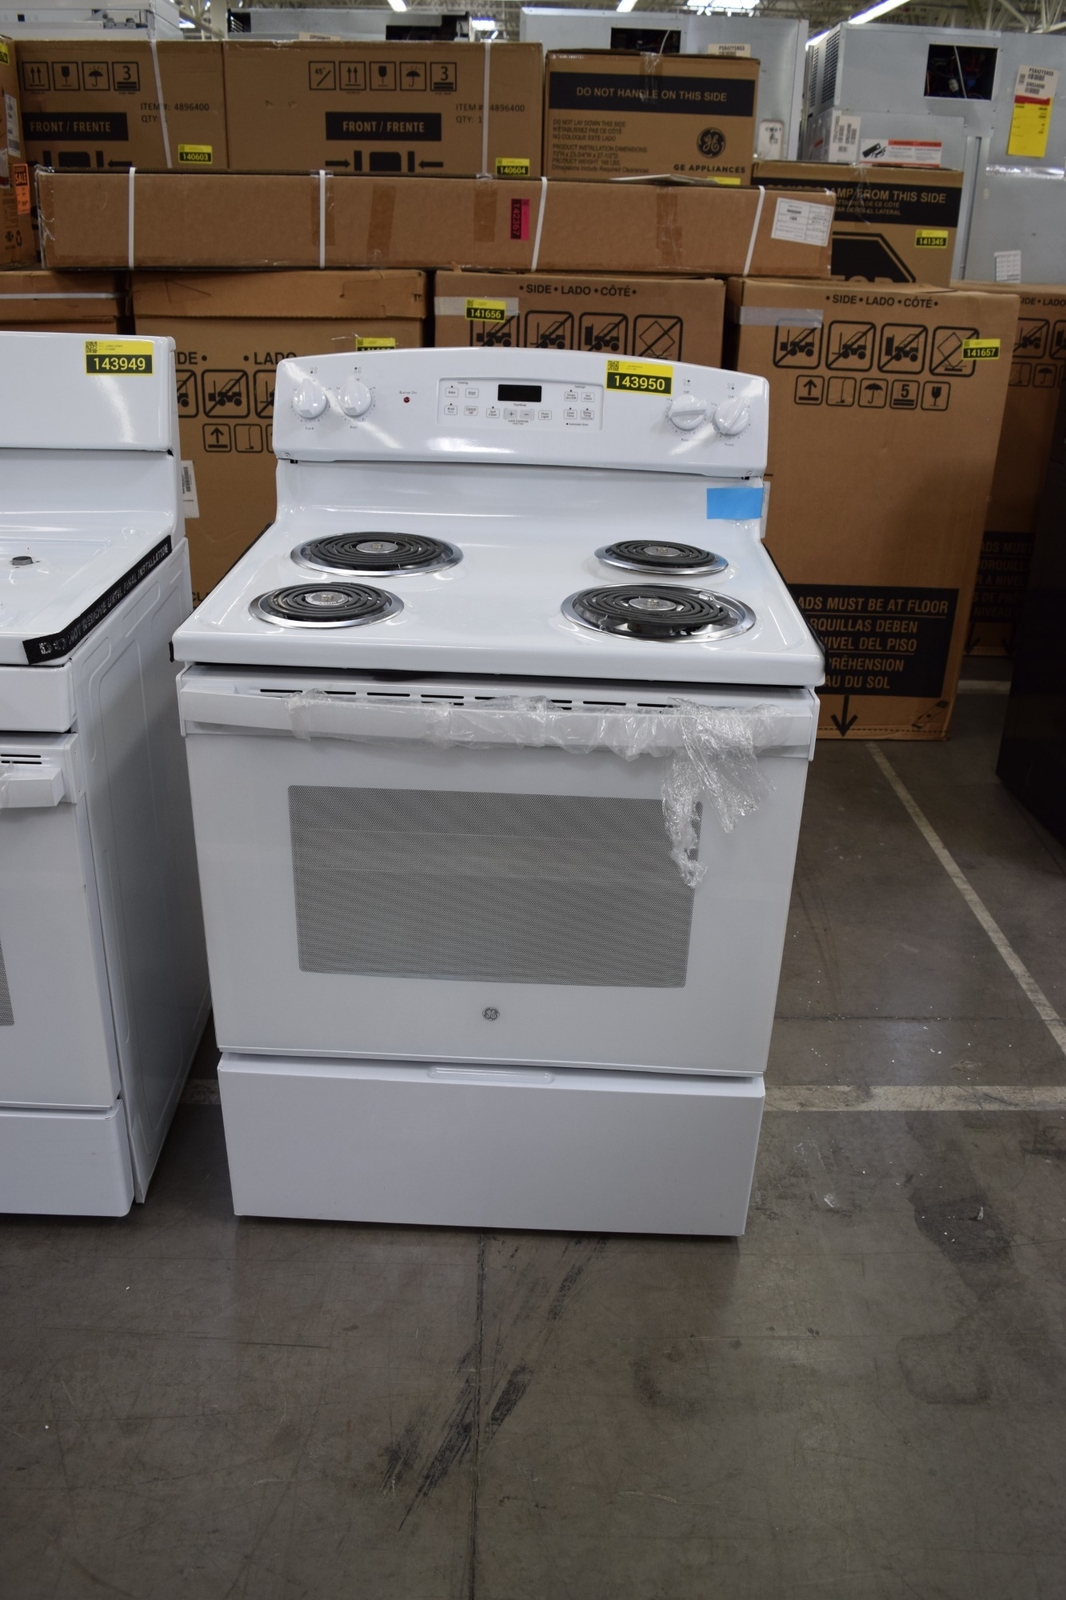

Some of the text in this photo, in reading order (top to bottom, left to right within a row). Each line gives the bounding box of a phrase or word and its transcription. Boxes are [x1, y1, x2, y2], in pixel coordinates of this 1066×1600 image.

[576, 86, 727, 103] DO NOT HANDLE ON THIS SIDE
[140, 103, 159, 111] ITEM
[174, 103, 210, 112] 4896400
[456, 104, 476, 112] ITEM
[490, 104, 526, 112] 4896400
[30, 121, 64, 133] FRONT
[74, 122, 111, 133] FRENTE
[343, 121, 377, 132] FRONT
[386, 122, 425, 133] FRENTE
[183, 152, 209, 161] 140603
[500, 164, 526, 174] 140604
[674, 164, 746, 174] GE APPLIANCES
[857, 188, 890, 200] FROM
[893, 190, 917, 201] THIS
[920, 191, 946, 204] SIDE
[512, 203, 521, 236] 142367
[919, 237, 944, 246] 141345
[526, 284, 631, 297] SIDE LADO CÔTÉ
[832, 294, 933, 309] SIDE LADO CÔTÉ
[470, 308, 502, 320] 141656
[967, 347, 997, 358] 141657
[94, 357, 146, 371] 143949
[614, 375, 666, 391] 143950
[901, 383, 910, 398] 5
[798, 596, 949, 614] ADS MUST BE AT FLOOR
[809, 617, 918, 634] RQUILLAS DEBEN
[859, 637, 884, 651] DEL
[887, 638, 917, 652] PISO
[844, 675, 863, 688] DU
[866, 676, 890, 689] SOL
